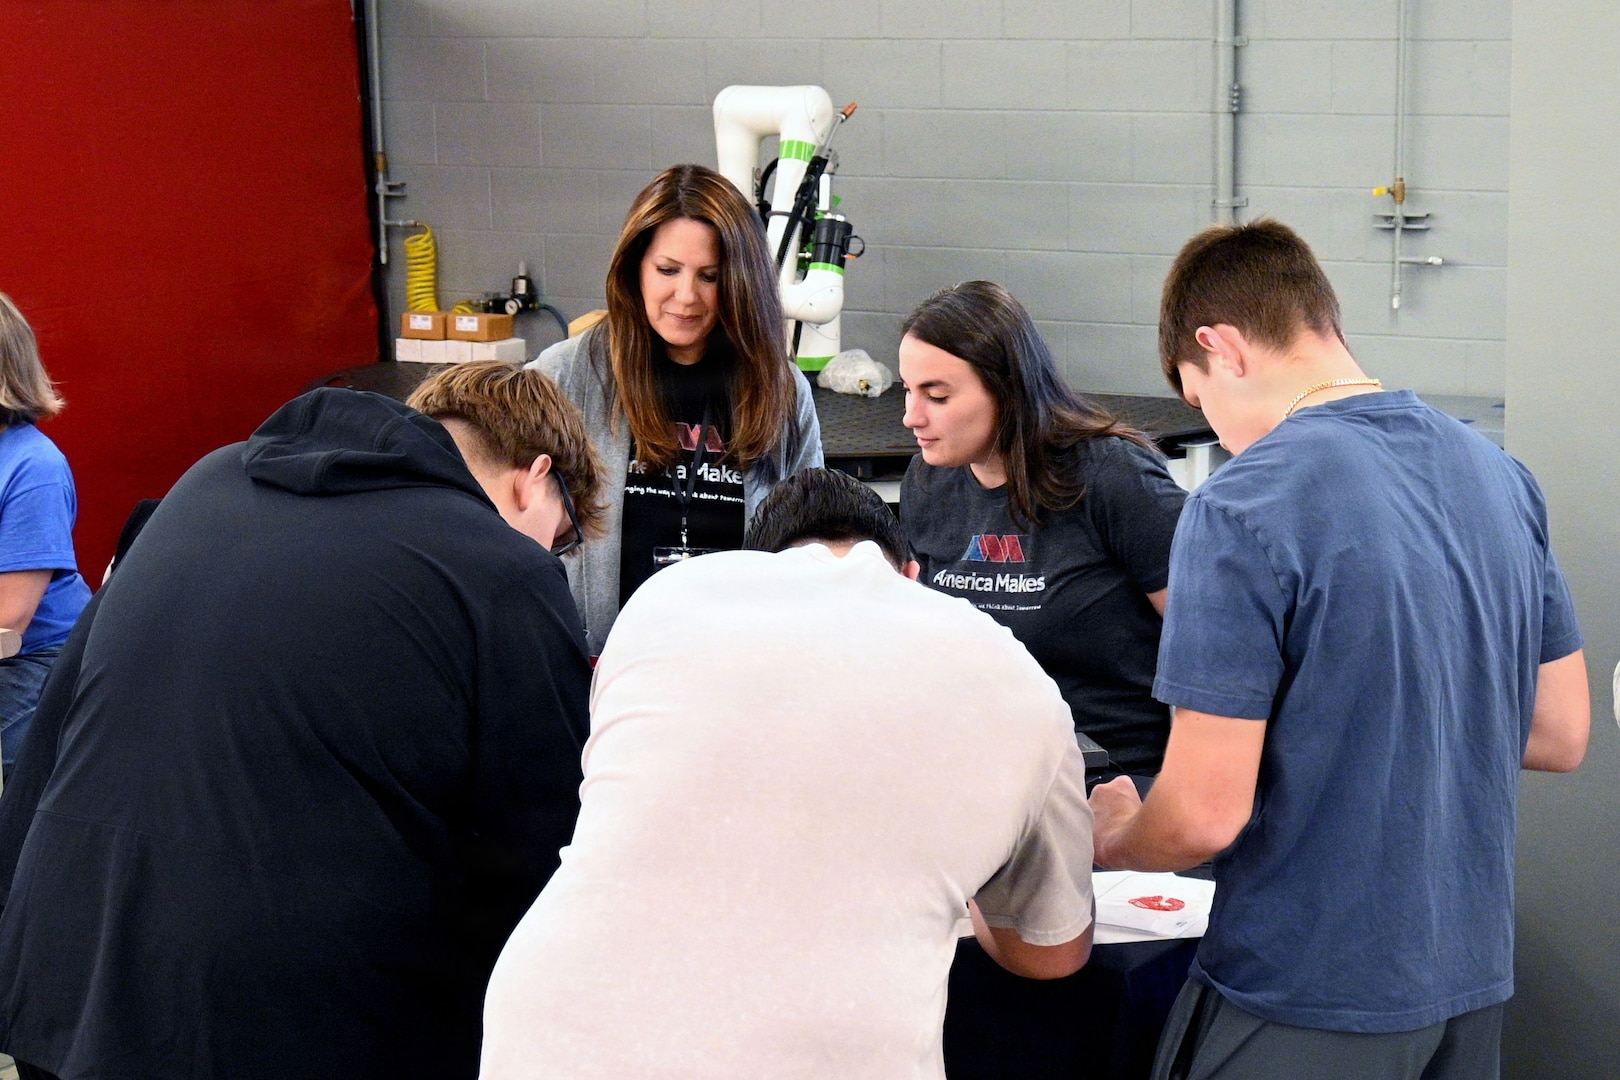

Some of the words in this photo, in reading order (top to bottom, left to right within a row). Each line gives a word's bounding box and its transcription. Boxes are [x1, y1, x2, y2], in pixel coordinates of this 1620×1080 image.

[691, 462, 743, 485] Make
[933, 569, 993, 592] America
[995, 573, 1046, 593] Makes
